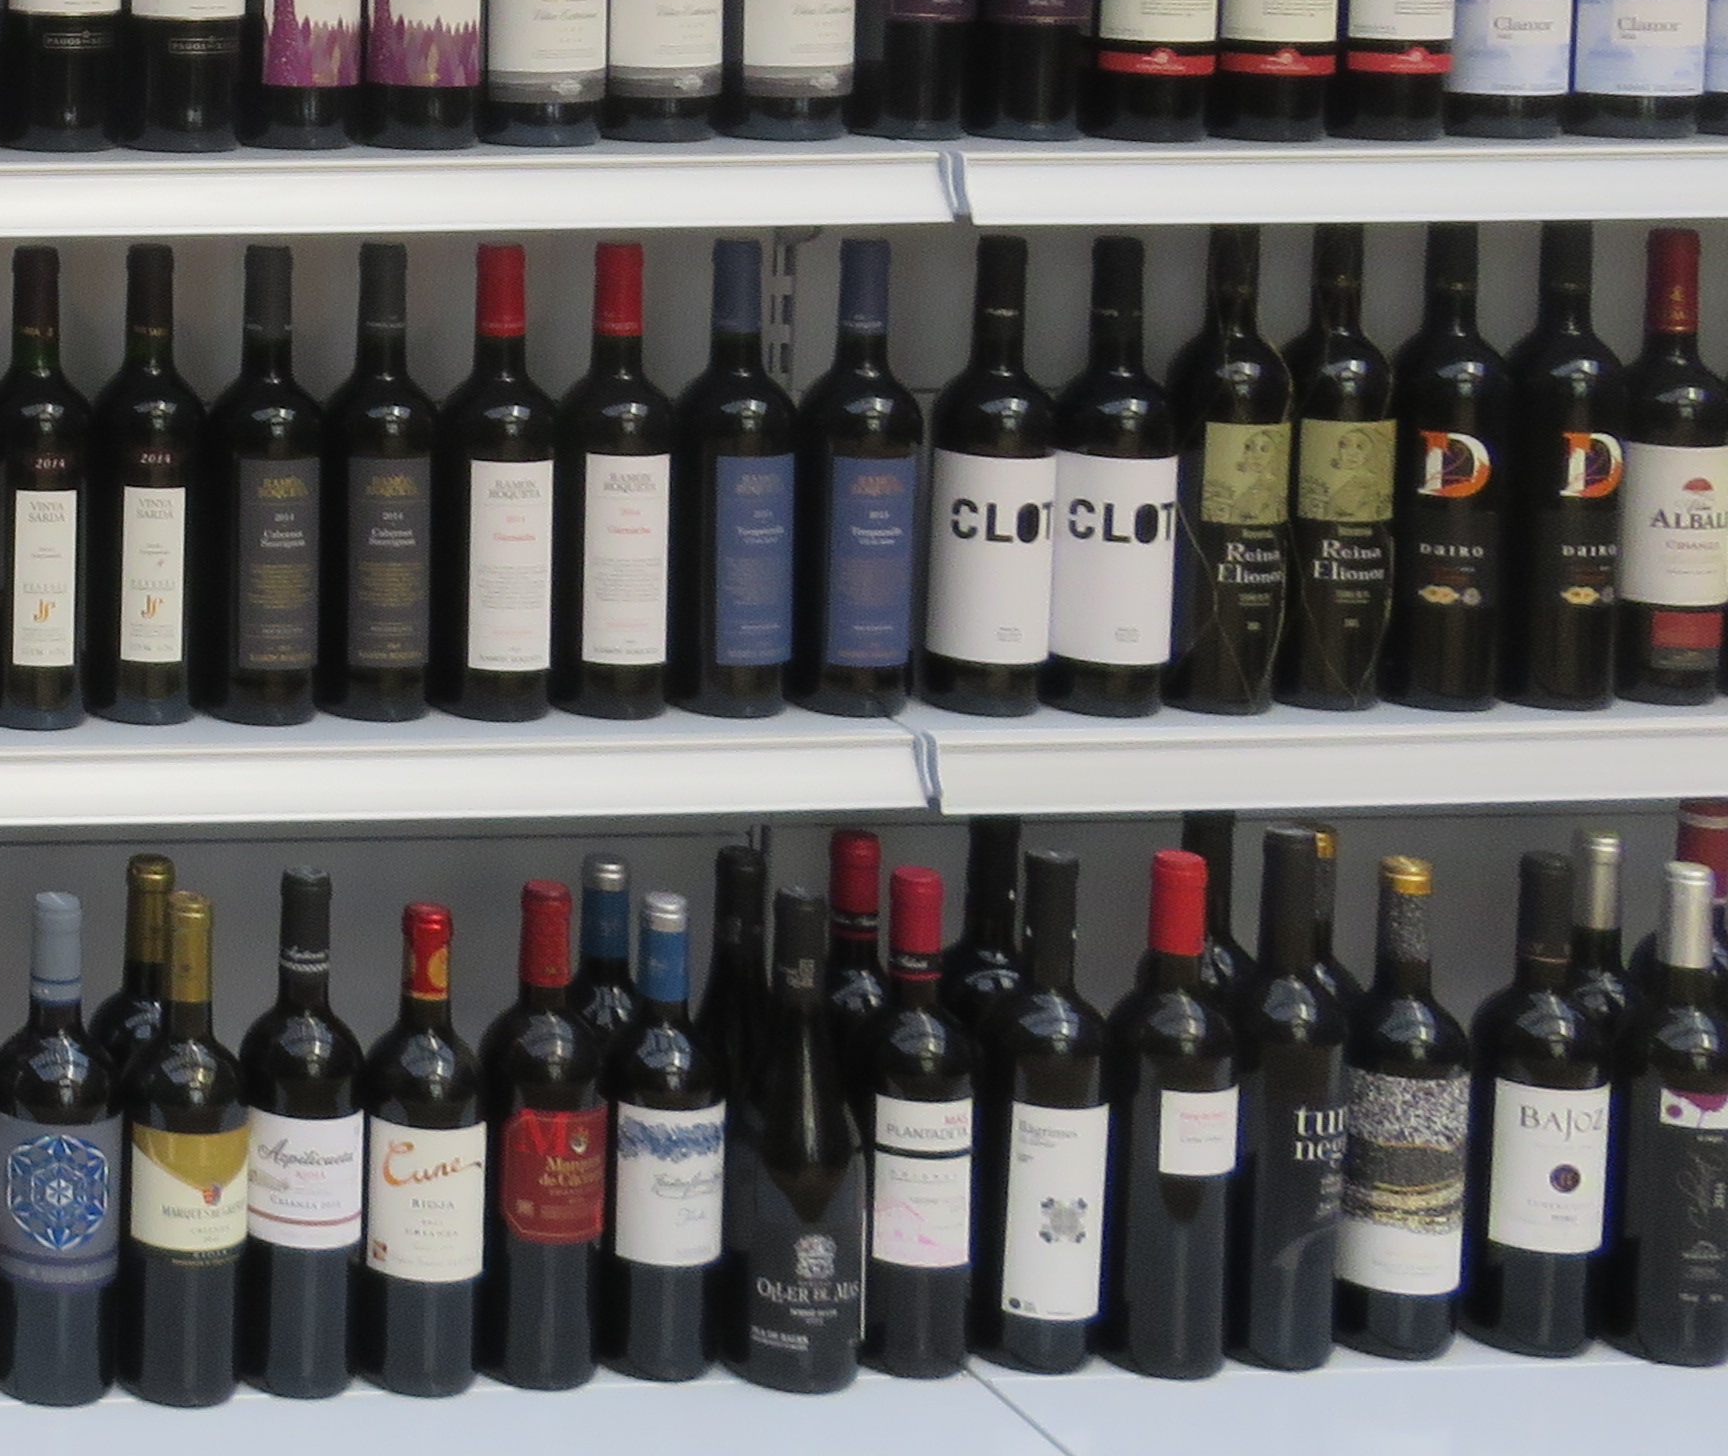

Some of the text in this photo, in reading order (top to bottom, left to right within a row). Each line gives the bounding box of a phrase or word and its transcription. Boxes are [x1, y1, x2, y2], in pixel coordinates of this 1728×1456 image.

[950, 497, 1056, 544] CLOT
[1067, 497, 1177, 544] CLOT
[1224, 542, 1280, 565] Reina
[1319, 540, 1382, 563] Reina
[1519, 1104, 1604, 1143] BAJOZ
